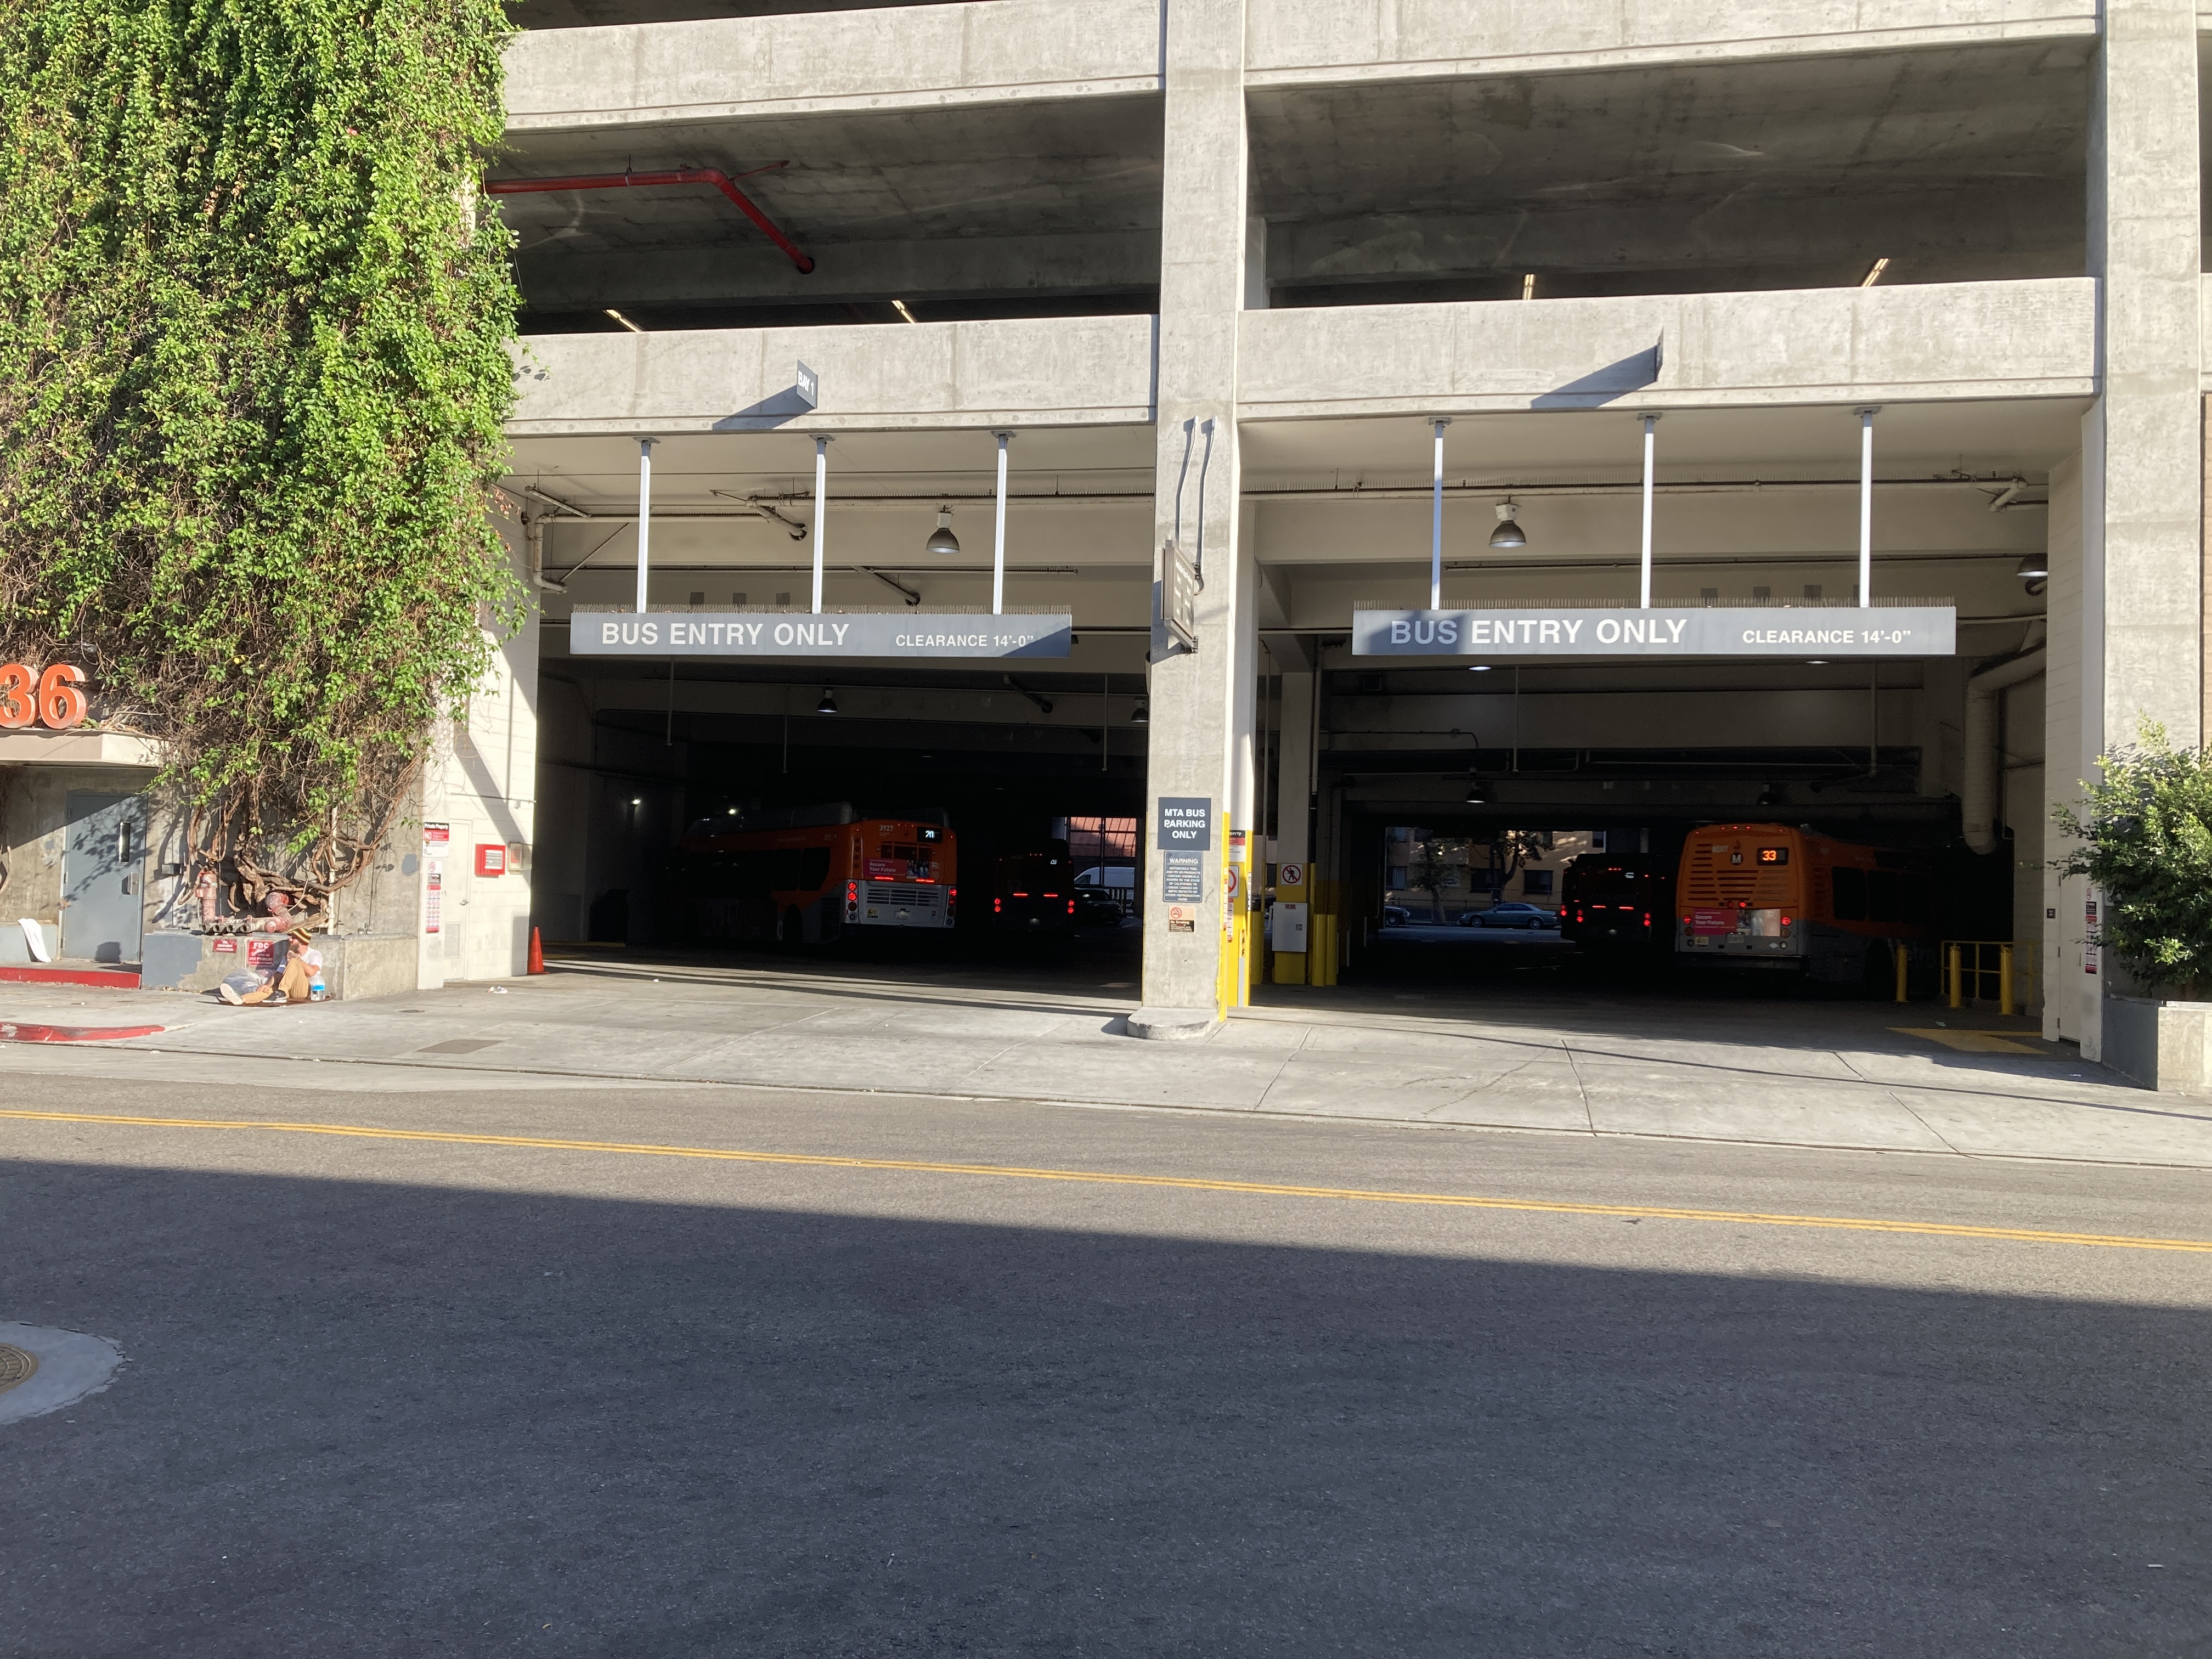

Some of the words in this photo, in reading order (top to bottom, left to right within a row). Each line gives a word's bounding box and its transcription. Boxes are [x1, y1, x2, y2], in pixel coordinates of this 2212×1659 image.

[798, 370, 810, 392] BAY
[810, 381, 814, 396] 1
[602, 622, 658, 645] BUS
[670, 623, 764, 645] ENTRY
[774, 623, 850, 646] ONLY
[1390, 620, 1459, 645] BUS
[1471, 619, 1584, 644] ENTRY
[1596, 619, 1688, 644] ONLY
[1742, 630, 1854, 644] CLEARANCE
[895, 634, 988, 647] CLEARANCE
[1164, 808, 1184, 817] MTA
[1186, 809, 1205, 817] BUS
[1164, 819, 1205, 828] PARKING
[424, 831, 432, 839] NO
[1172, 830, 1197, 839] ONLY
[1762, 850, 1777, 861] 33
